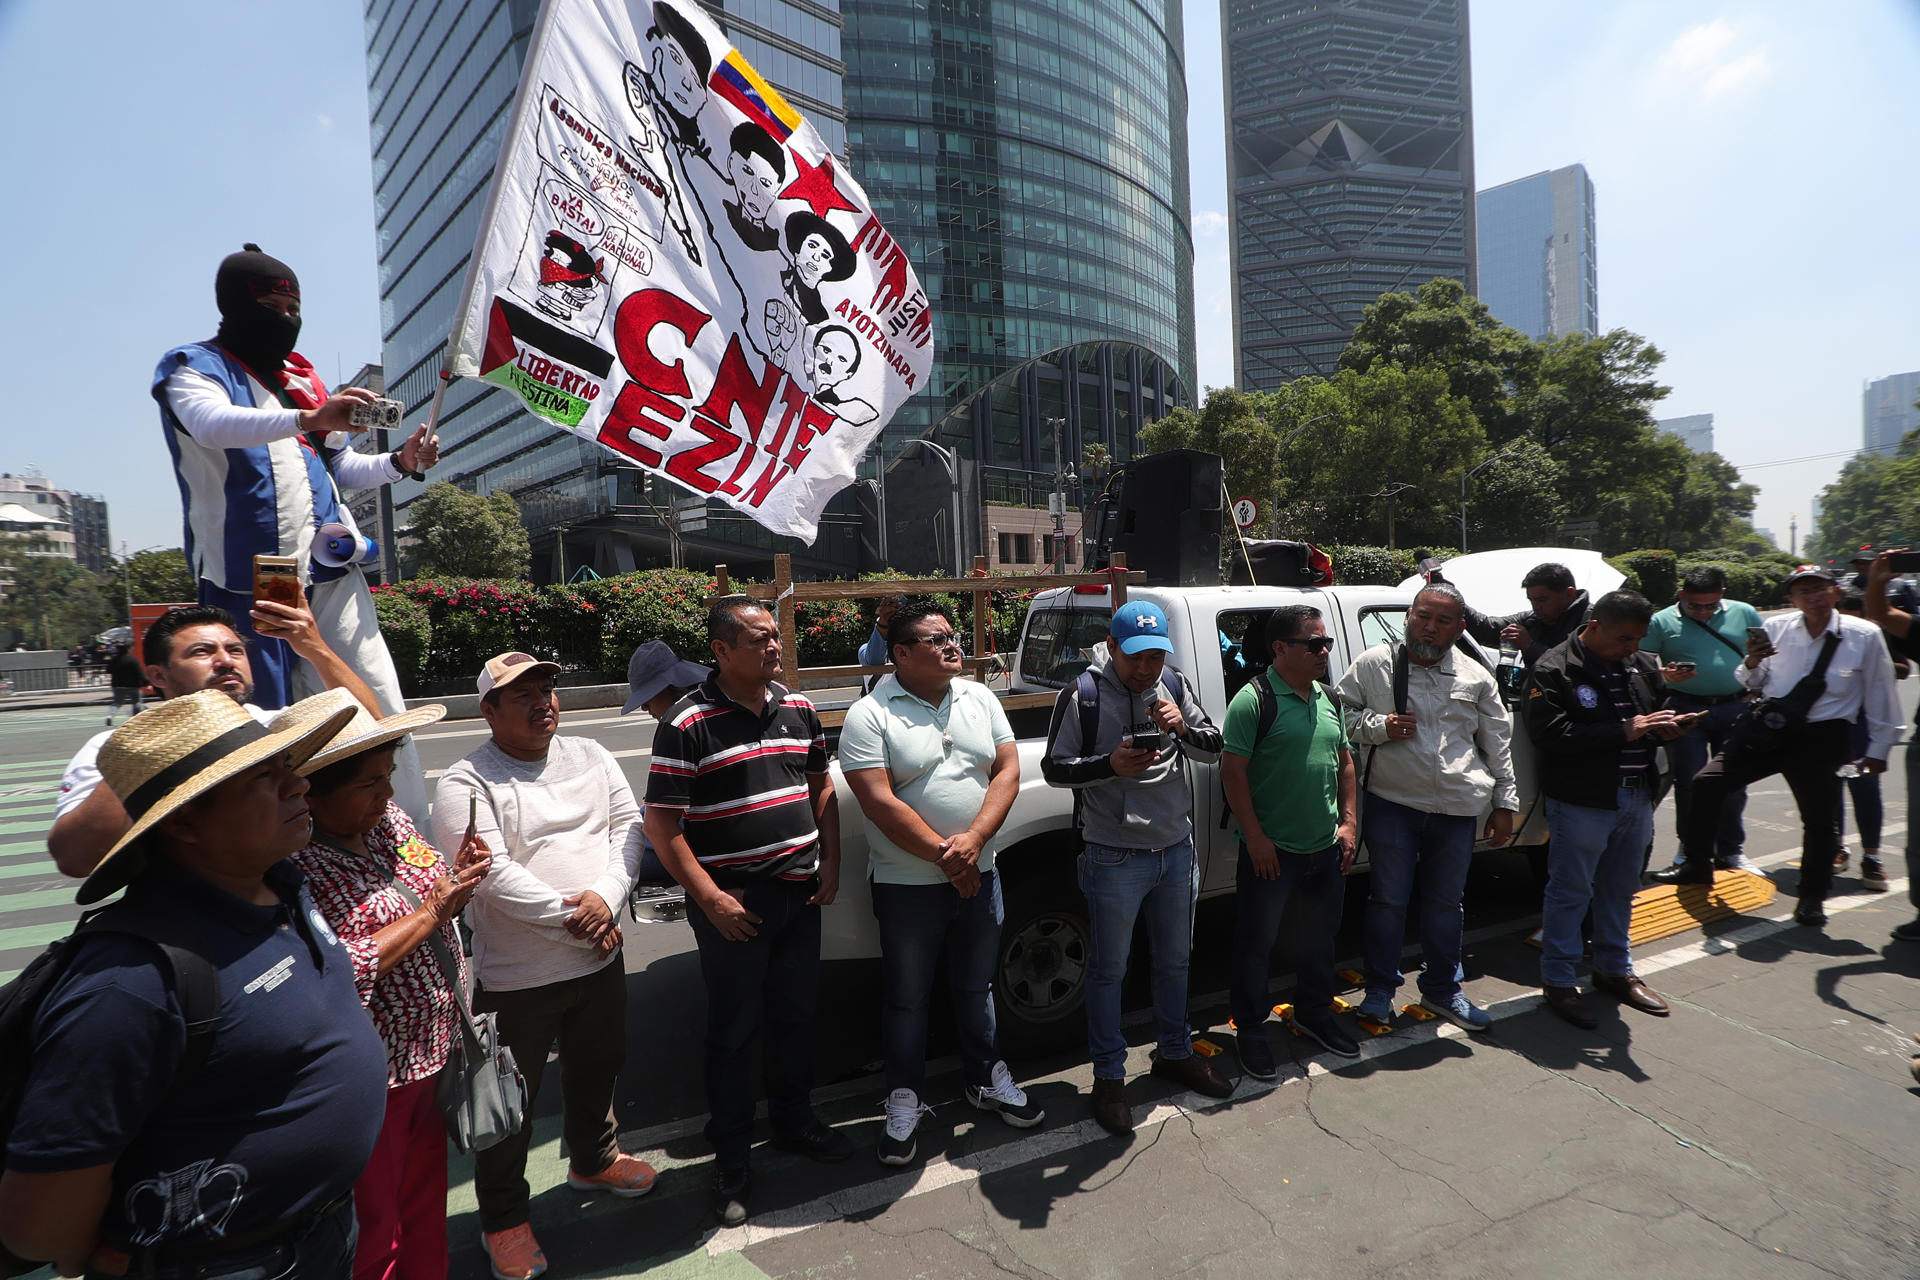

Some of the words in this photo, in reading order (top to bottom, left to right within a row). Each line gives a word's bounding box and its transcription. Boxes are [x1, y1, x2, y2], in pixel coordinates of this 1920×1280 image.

[550, 98, 613, 158] Asamblea
[551, 193, 596, 233] BASTA!
[569, 191, 583, 212] YA
[601, 240, 647, 274] NACIONAL
[606, 231, 618, 242] DE
[619, 238, 645, 260] LUTO
[834, 297, 917, 391] AYOTZINAPA
[517, 347, 600, 401] LIBERTAD
[614, 288, 838, 474] CNTE
[597, 379, 790, 508] EZLN
